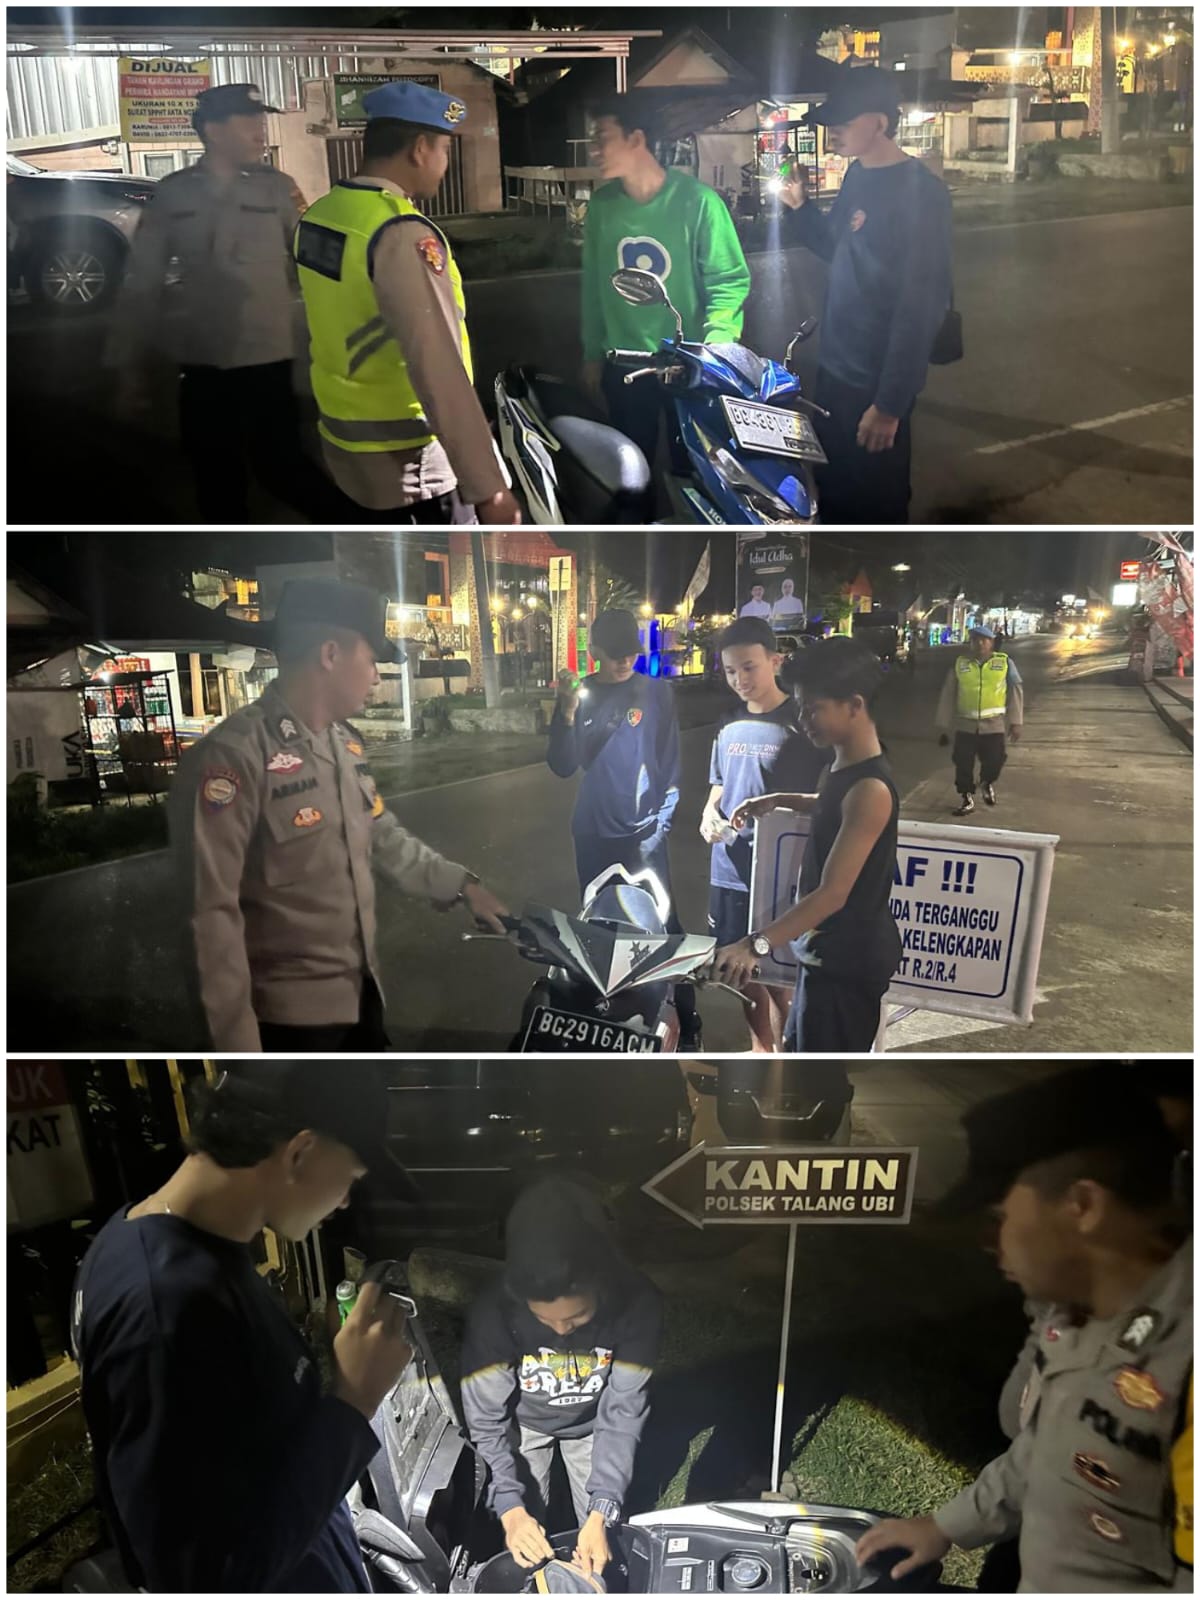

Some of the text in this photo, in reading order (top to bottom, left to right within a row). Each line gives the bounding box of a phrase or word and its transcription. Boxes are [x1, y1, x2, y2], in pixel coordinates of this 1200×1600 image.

[131, 61, 199, 73] DIJUAL
[727, 743, 747, 755] PRO
[915, 901, 999, 933] TERGANGGU
[902, 928, 1002, 961] KELENGKAPAN
[912, 958, 957, 983] R.2/R.4
[705, 1159, 899, 1191] KANTIN
[704, 1196, 895, 1212] POLSEK TALANG UBI
